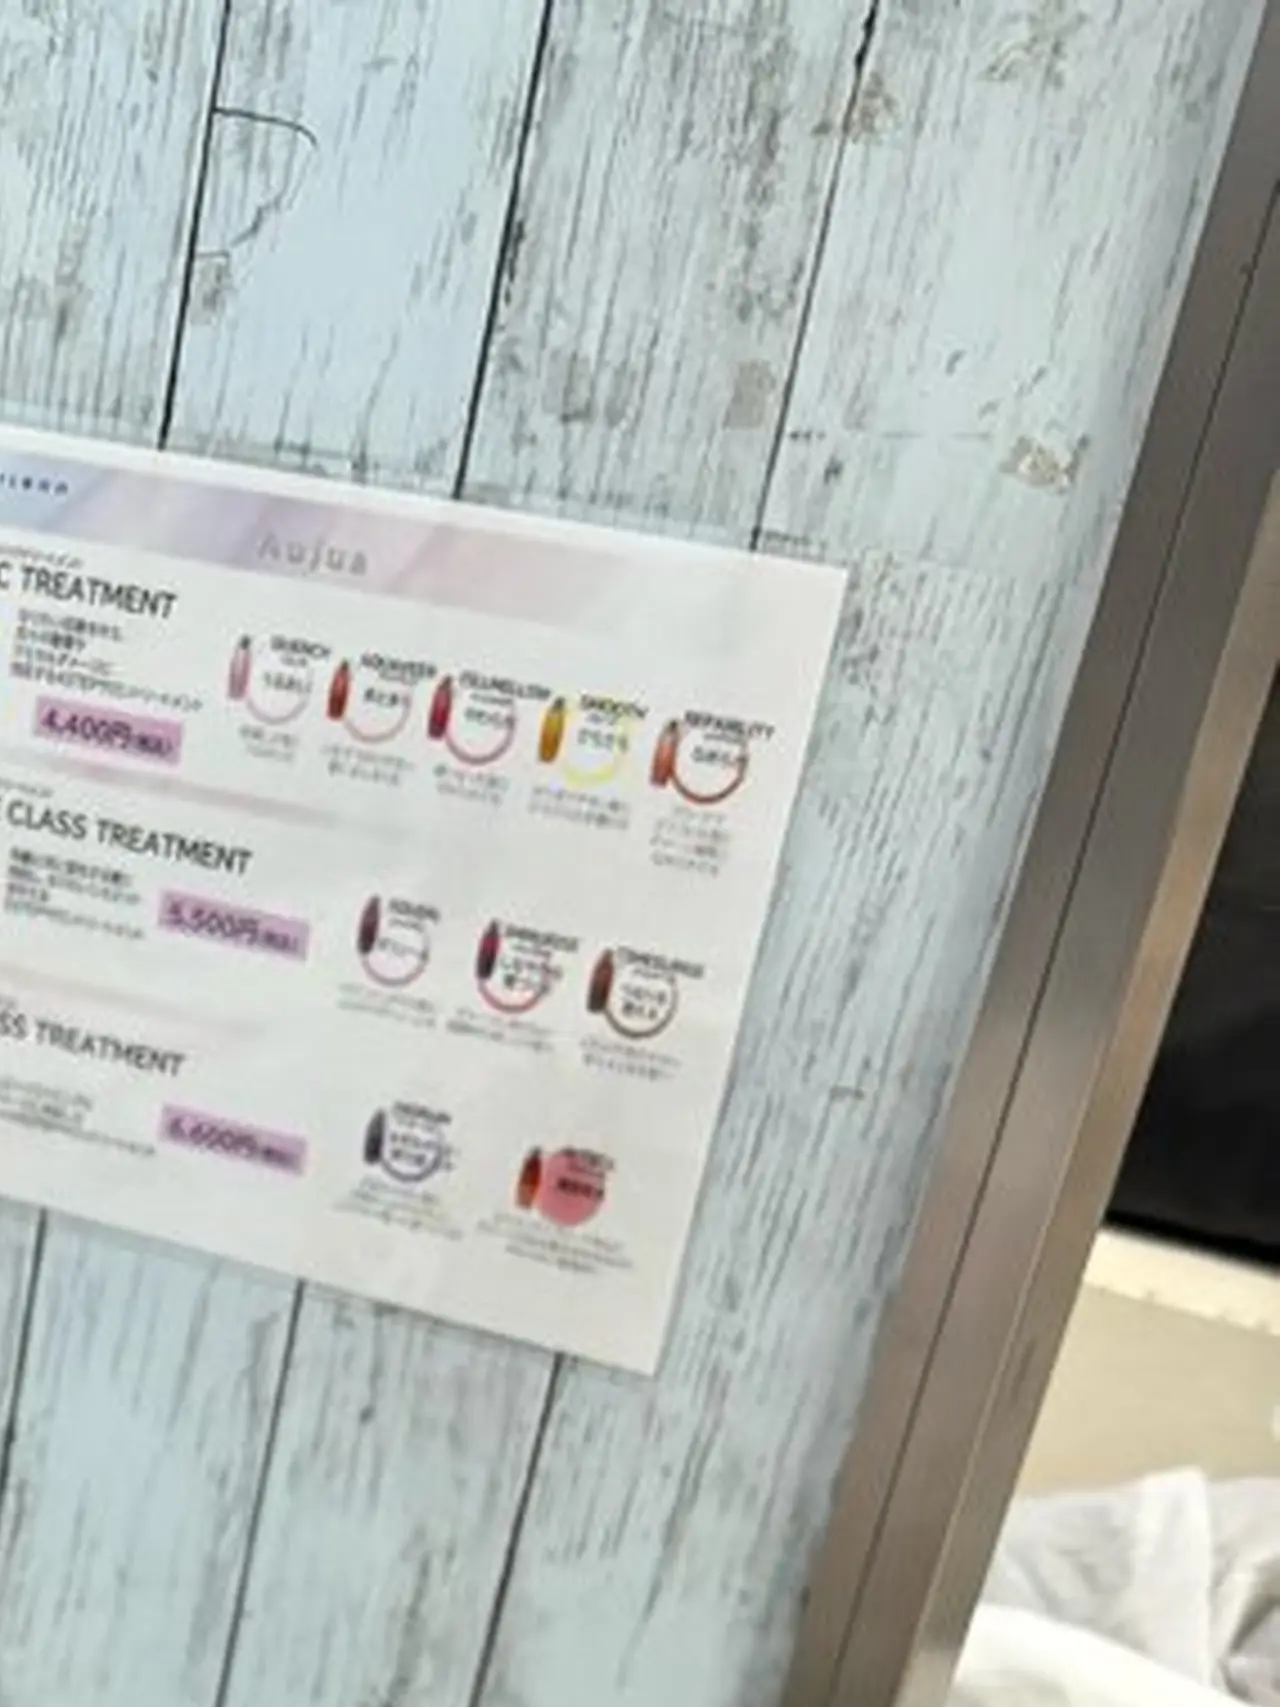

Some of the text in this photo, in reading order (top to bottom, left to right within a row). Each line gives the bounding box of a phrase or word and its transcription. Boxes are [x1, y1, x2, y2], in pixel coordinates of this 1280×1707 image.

[22, 566, 178, 619] TREATMENT
[7, 800, 88, 840] CLASS
[97, 818, 252, 875] TREATMENT
[36, 1020, 185, 1076] TREATMENT
